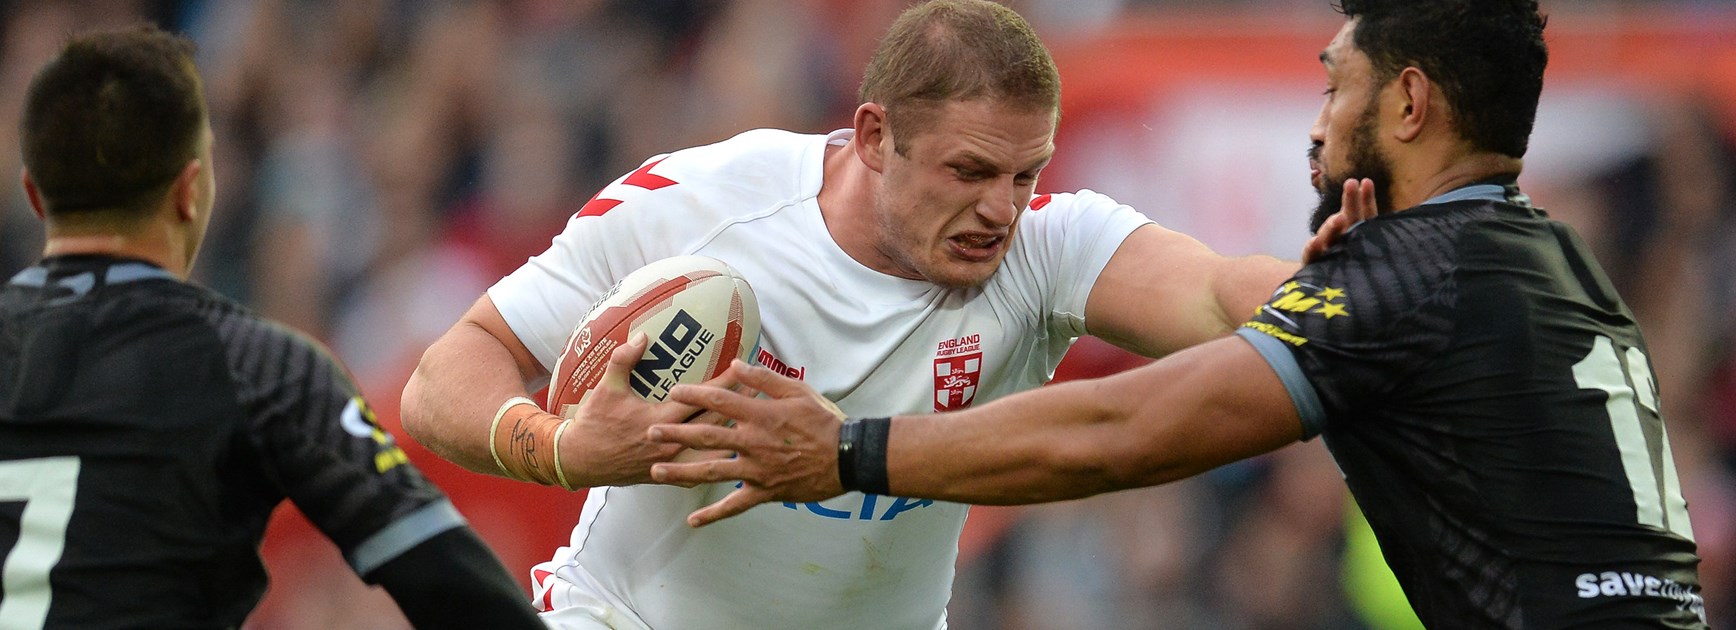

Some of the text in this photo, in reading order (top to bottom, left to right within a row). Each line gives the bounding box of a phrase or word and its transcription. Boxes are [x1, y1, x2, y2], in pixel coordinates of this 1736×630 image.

[936, 344, 980, 357] RUGBY LEAGUE
[938, 334, 980, 350] ENGLAND
[652, 328, 714, 402] LEAGUE
[758, 346, 805, 381] mmel
